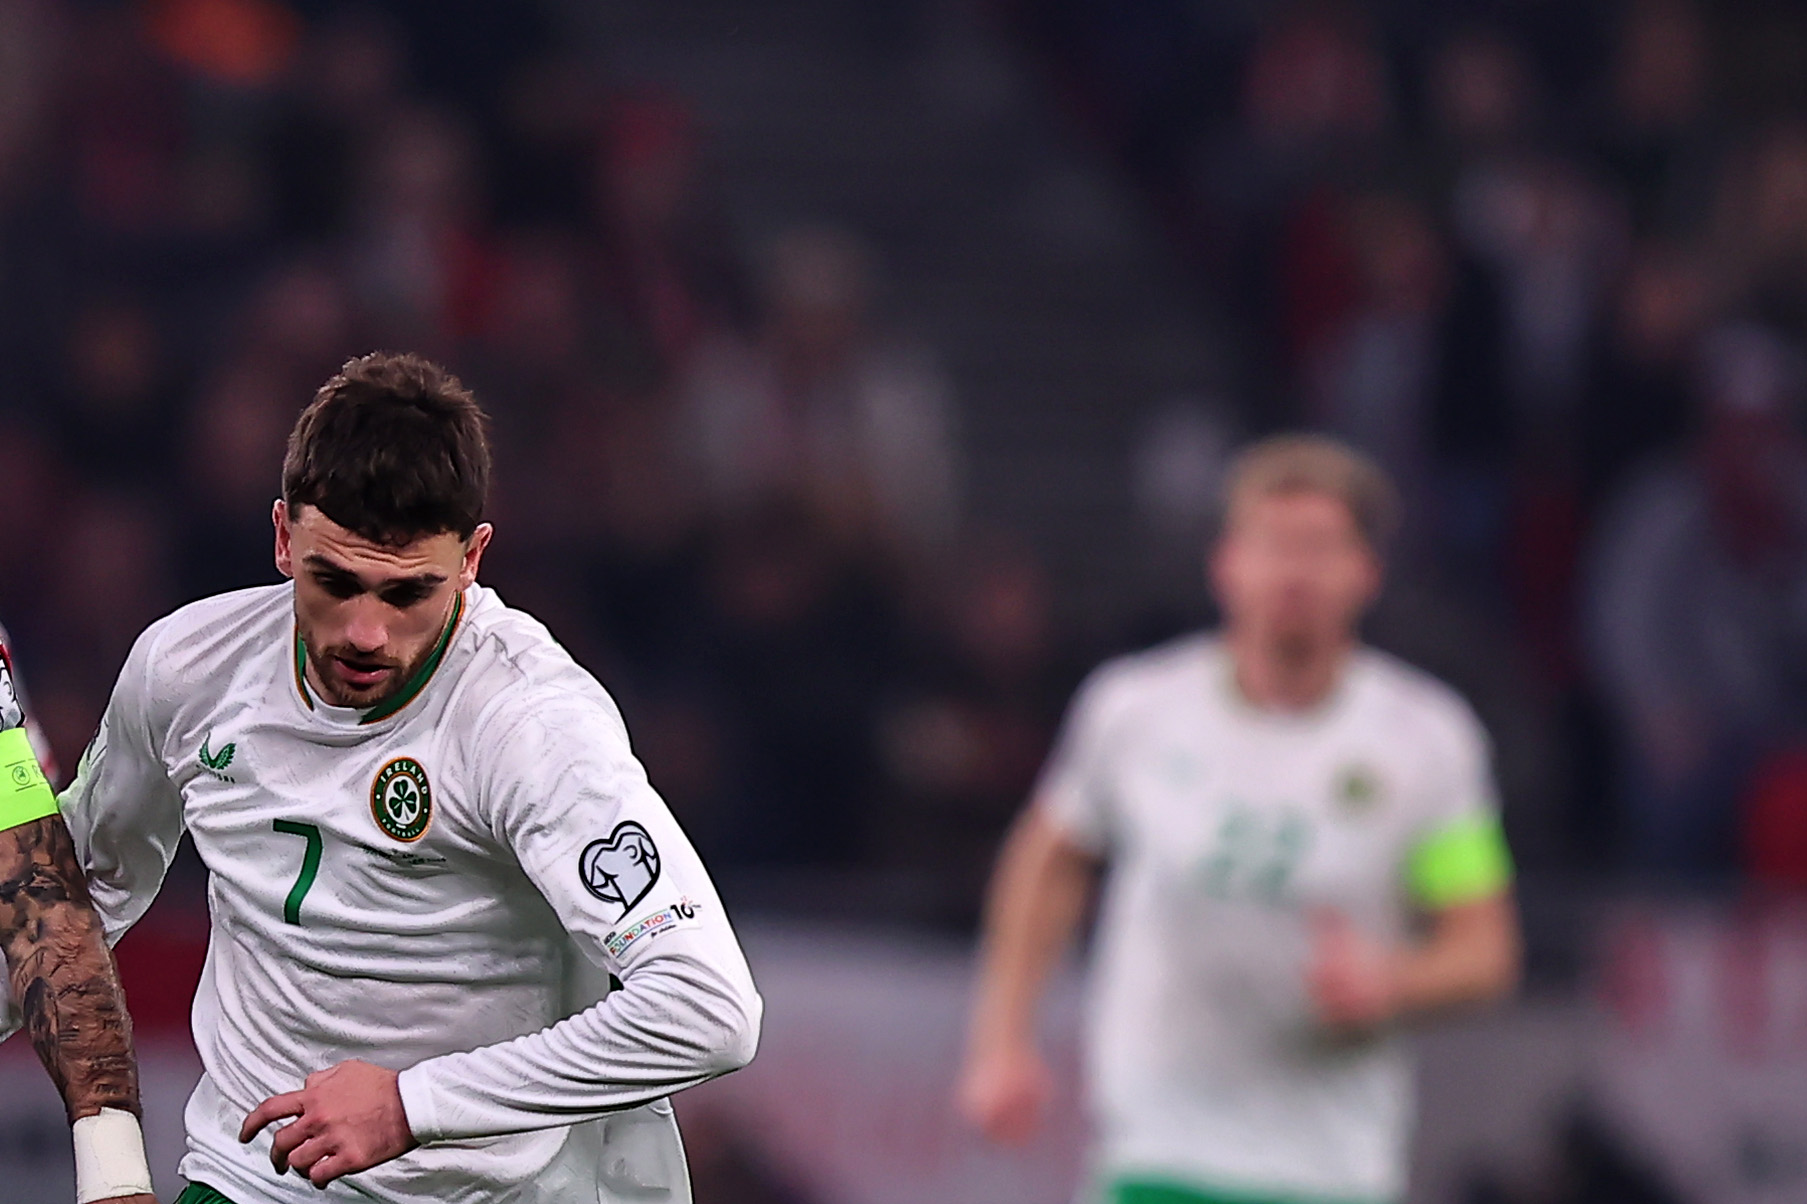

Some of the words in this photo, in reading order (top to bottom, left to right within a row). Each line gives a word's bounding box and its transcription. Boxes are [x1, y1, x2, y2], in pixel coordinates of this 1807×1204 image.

[380, 761, 428, 794] IRELAND
[272, 817, 323, 927] 7
[609, 911, 672, 956] FOUNDATION
